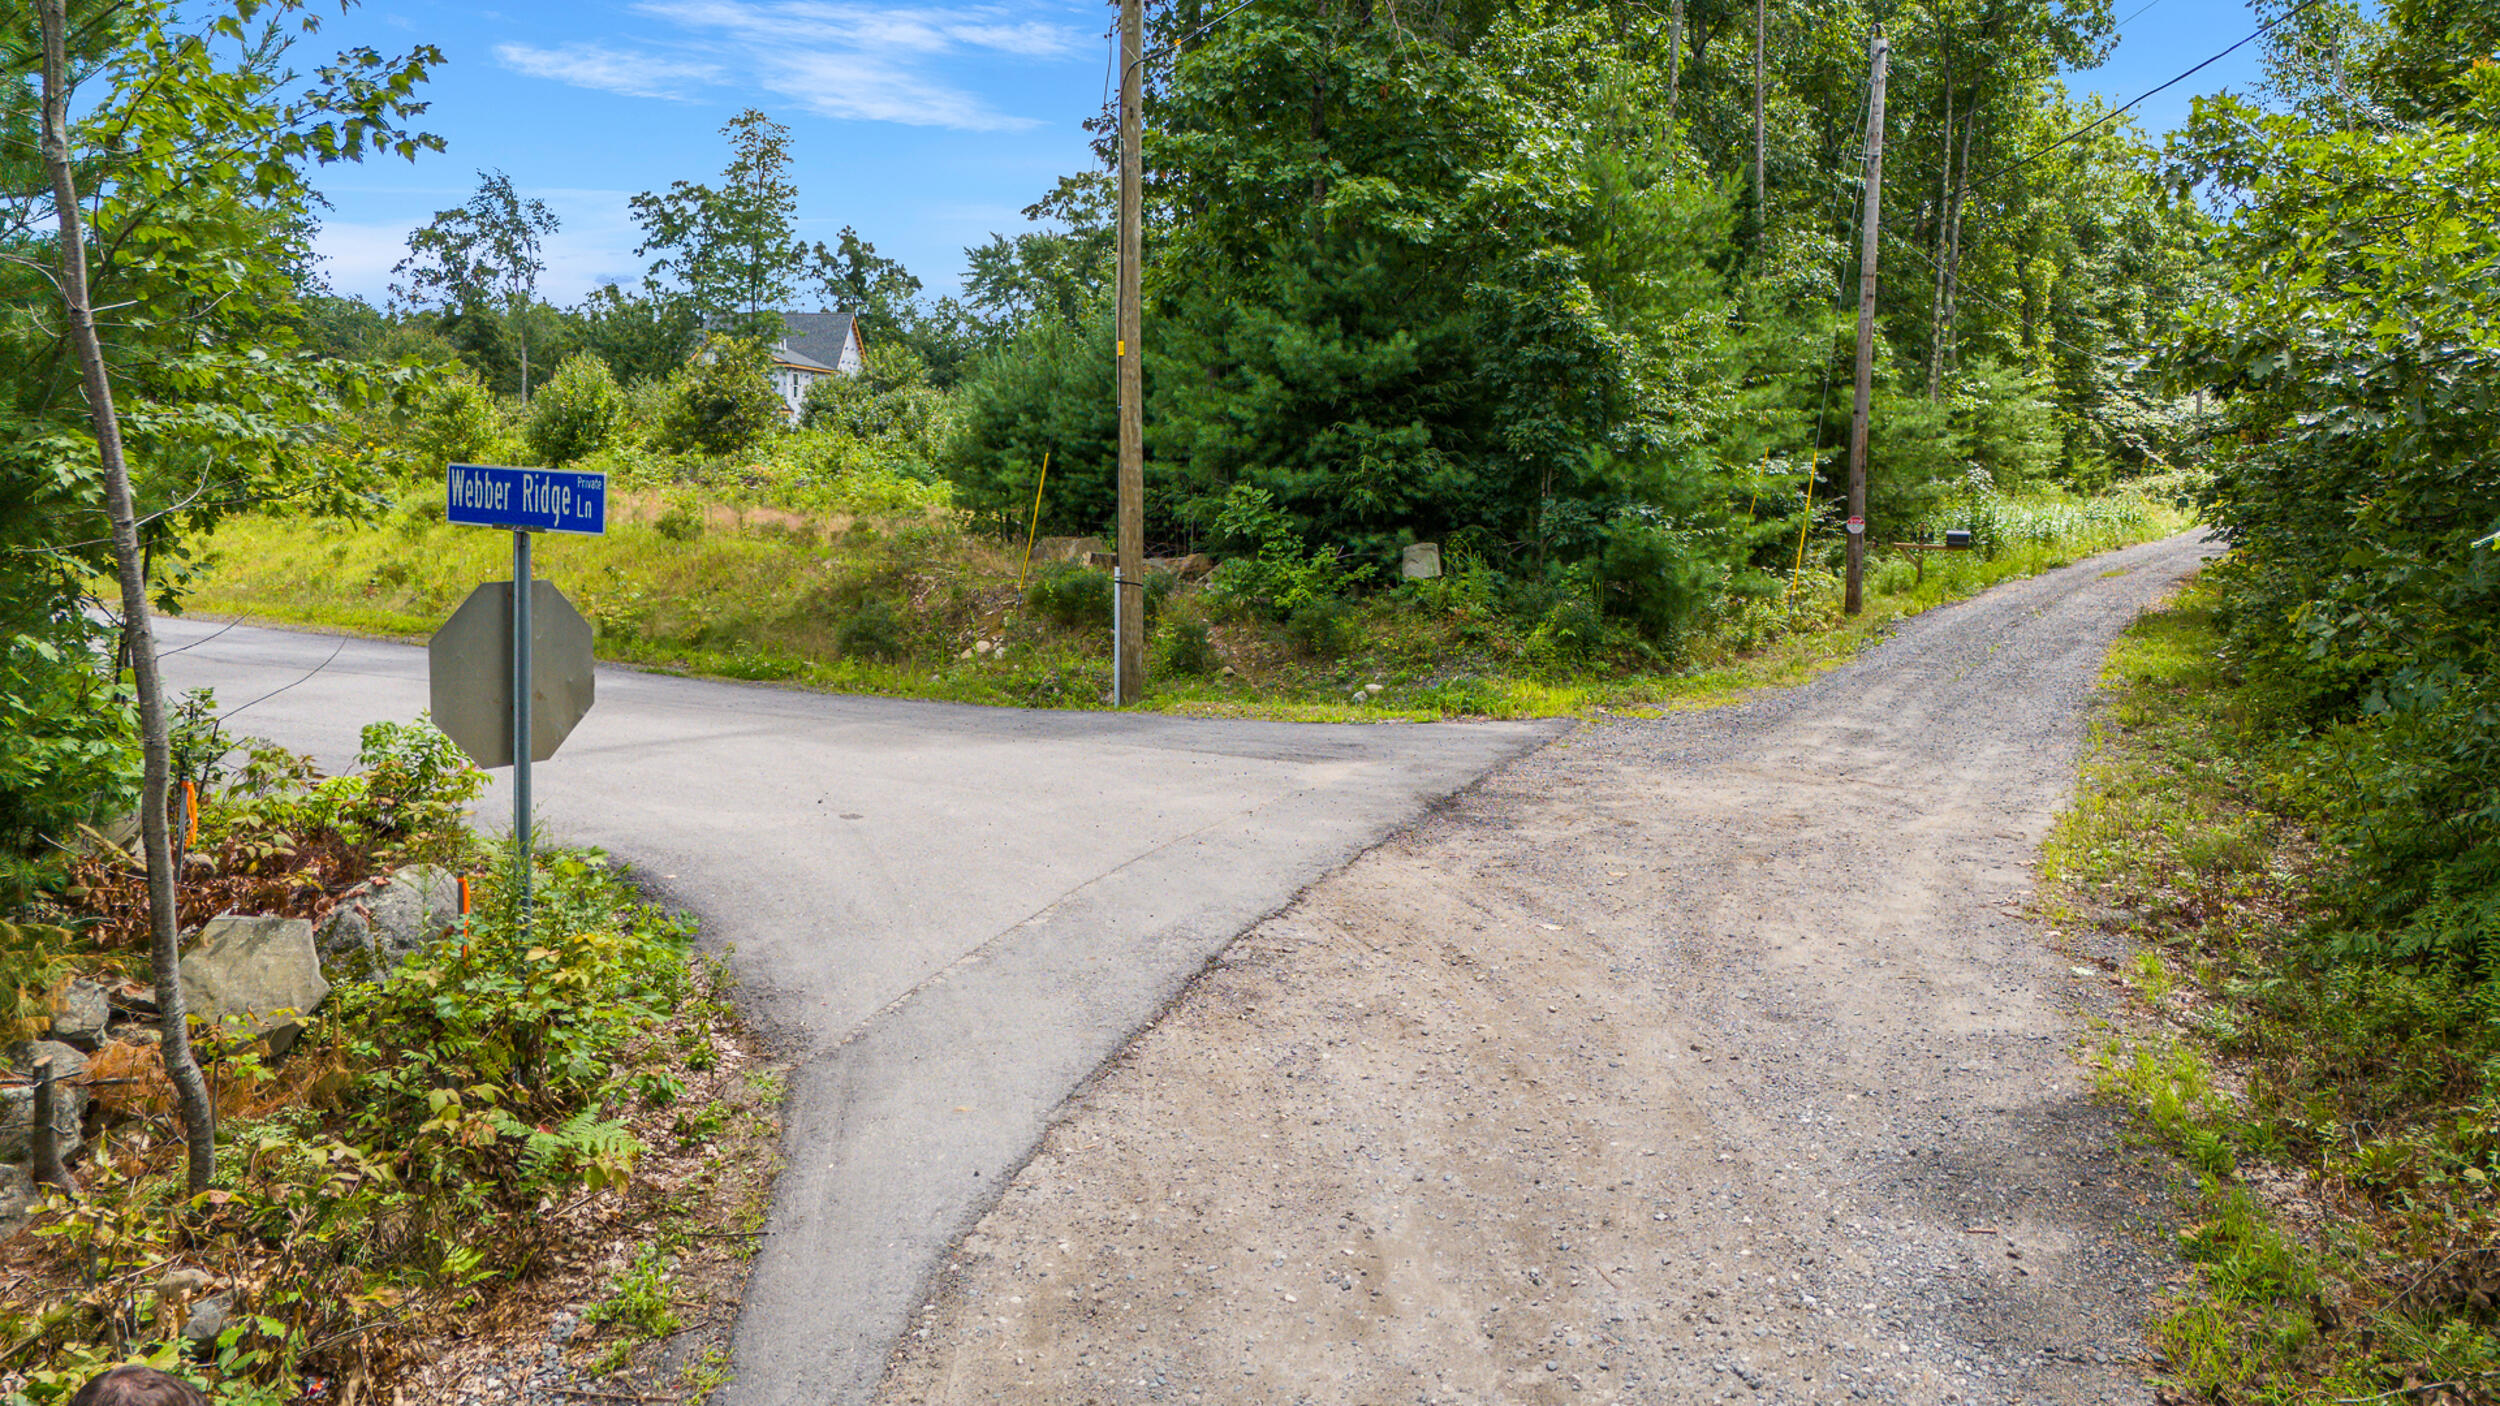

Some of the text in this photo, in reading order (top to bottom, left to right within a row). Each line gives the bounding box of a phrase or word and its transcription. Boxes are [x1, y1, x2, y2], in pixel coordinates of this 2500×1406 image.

[451, 468, 592, 527] Webber Ridge Ln
[577, 476, 602, 490] Private
